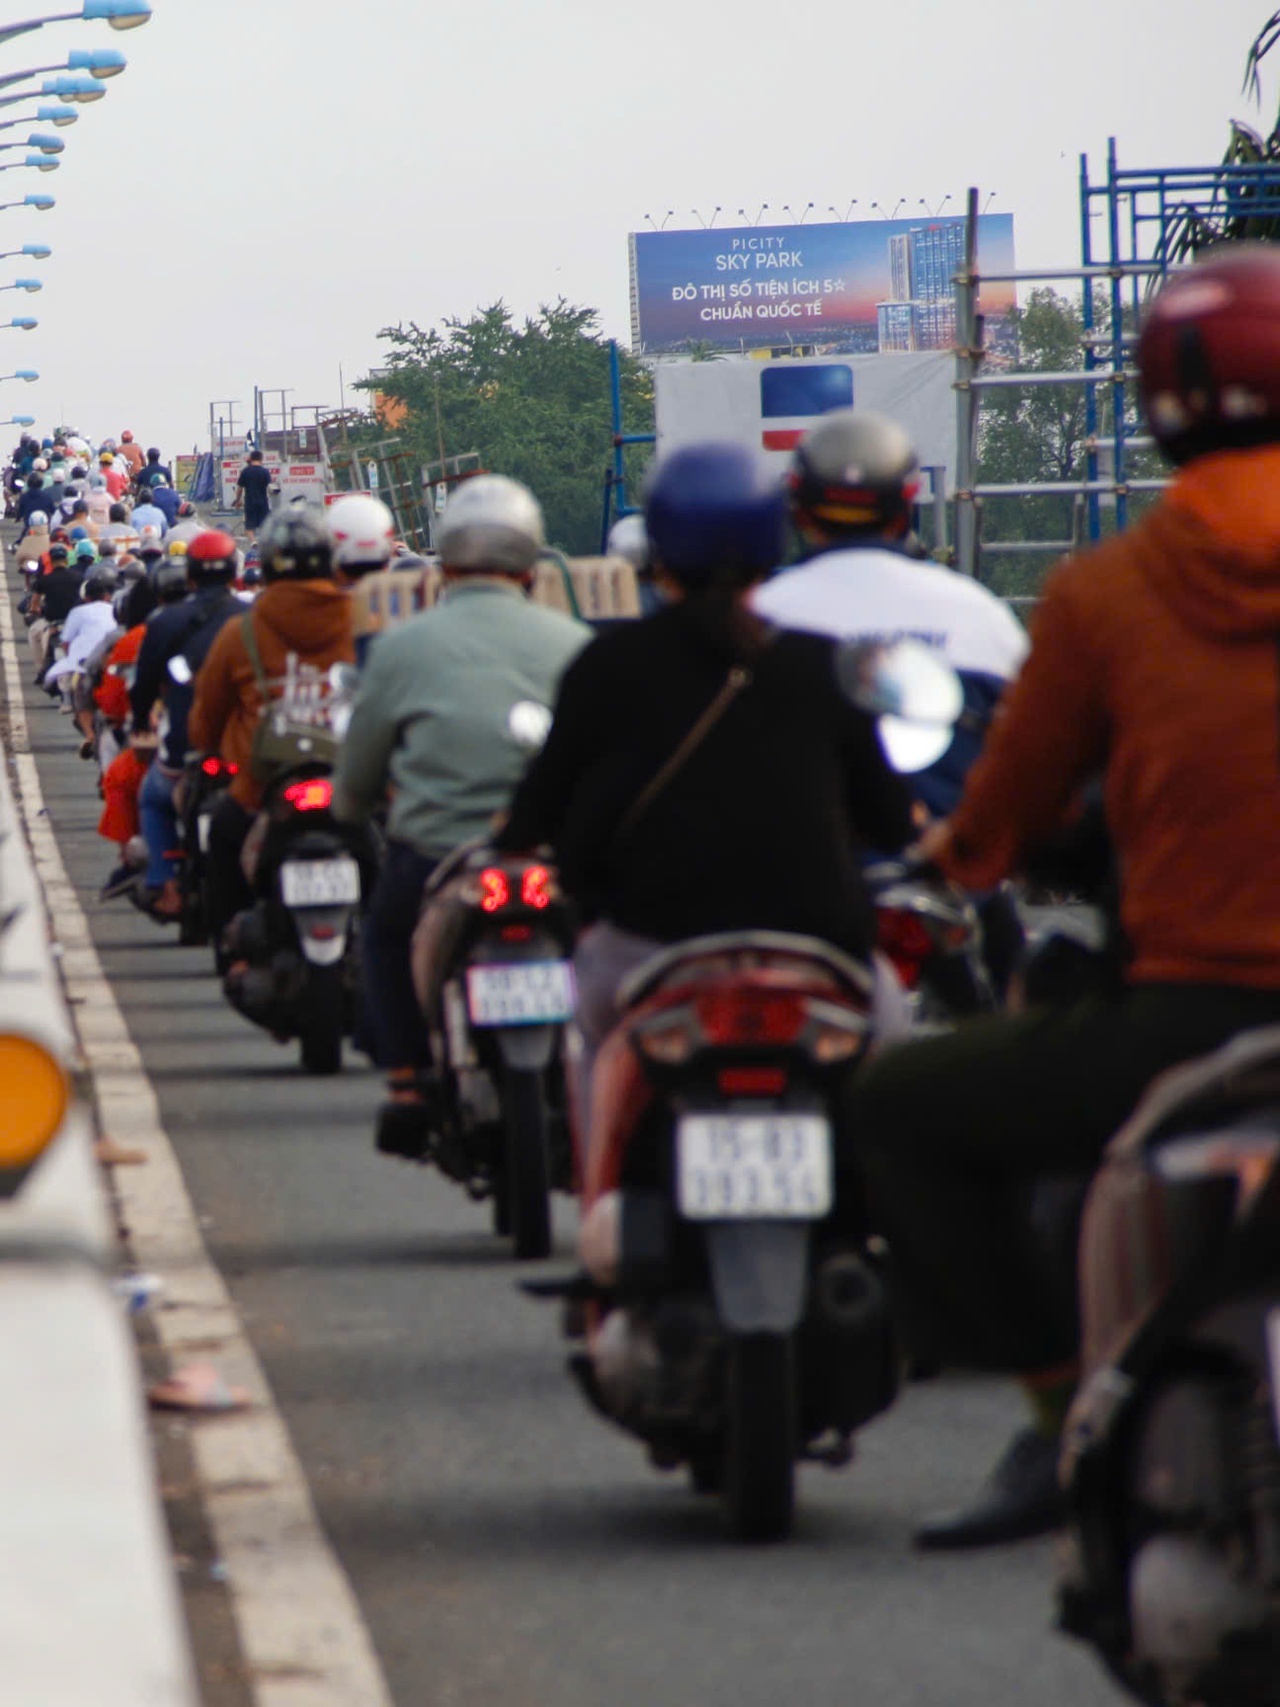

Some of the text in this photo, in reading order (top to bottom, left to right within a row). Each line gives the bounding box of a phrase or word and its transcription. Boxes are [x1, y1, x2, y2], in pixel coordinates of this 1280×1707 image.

[732, 236, 786, 250] PICITY
[716, 250, 804, 271] SKY PARK
[672, 282, 698, 301] ĐÔ
[700, 284, 726, 302] THỊ
[729, 278, 752, 297] SỐ
[755, 279, 789, 300] TIỆN
[792, 278, 820, 294] ÍCH
[756, 299, 802, 319] QUỐC
[804, 298, 823, 317] TẾ
